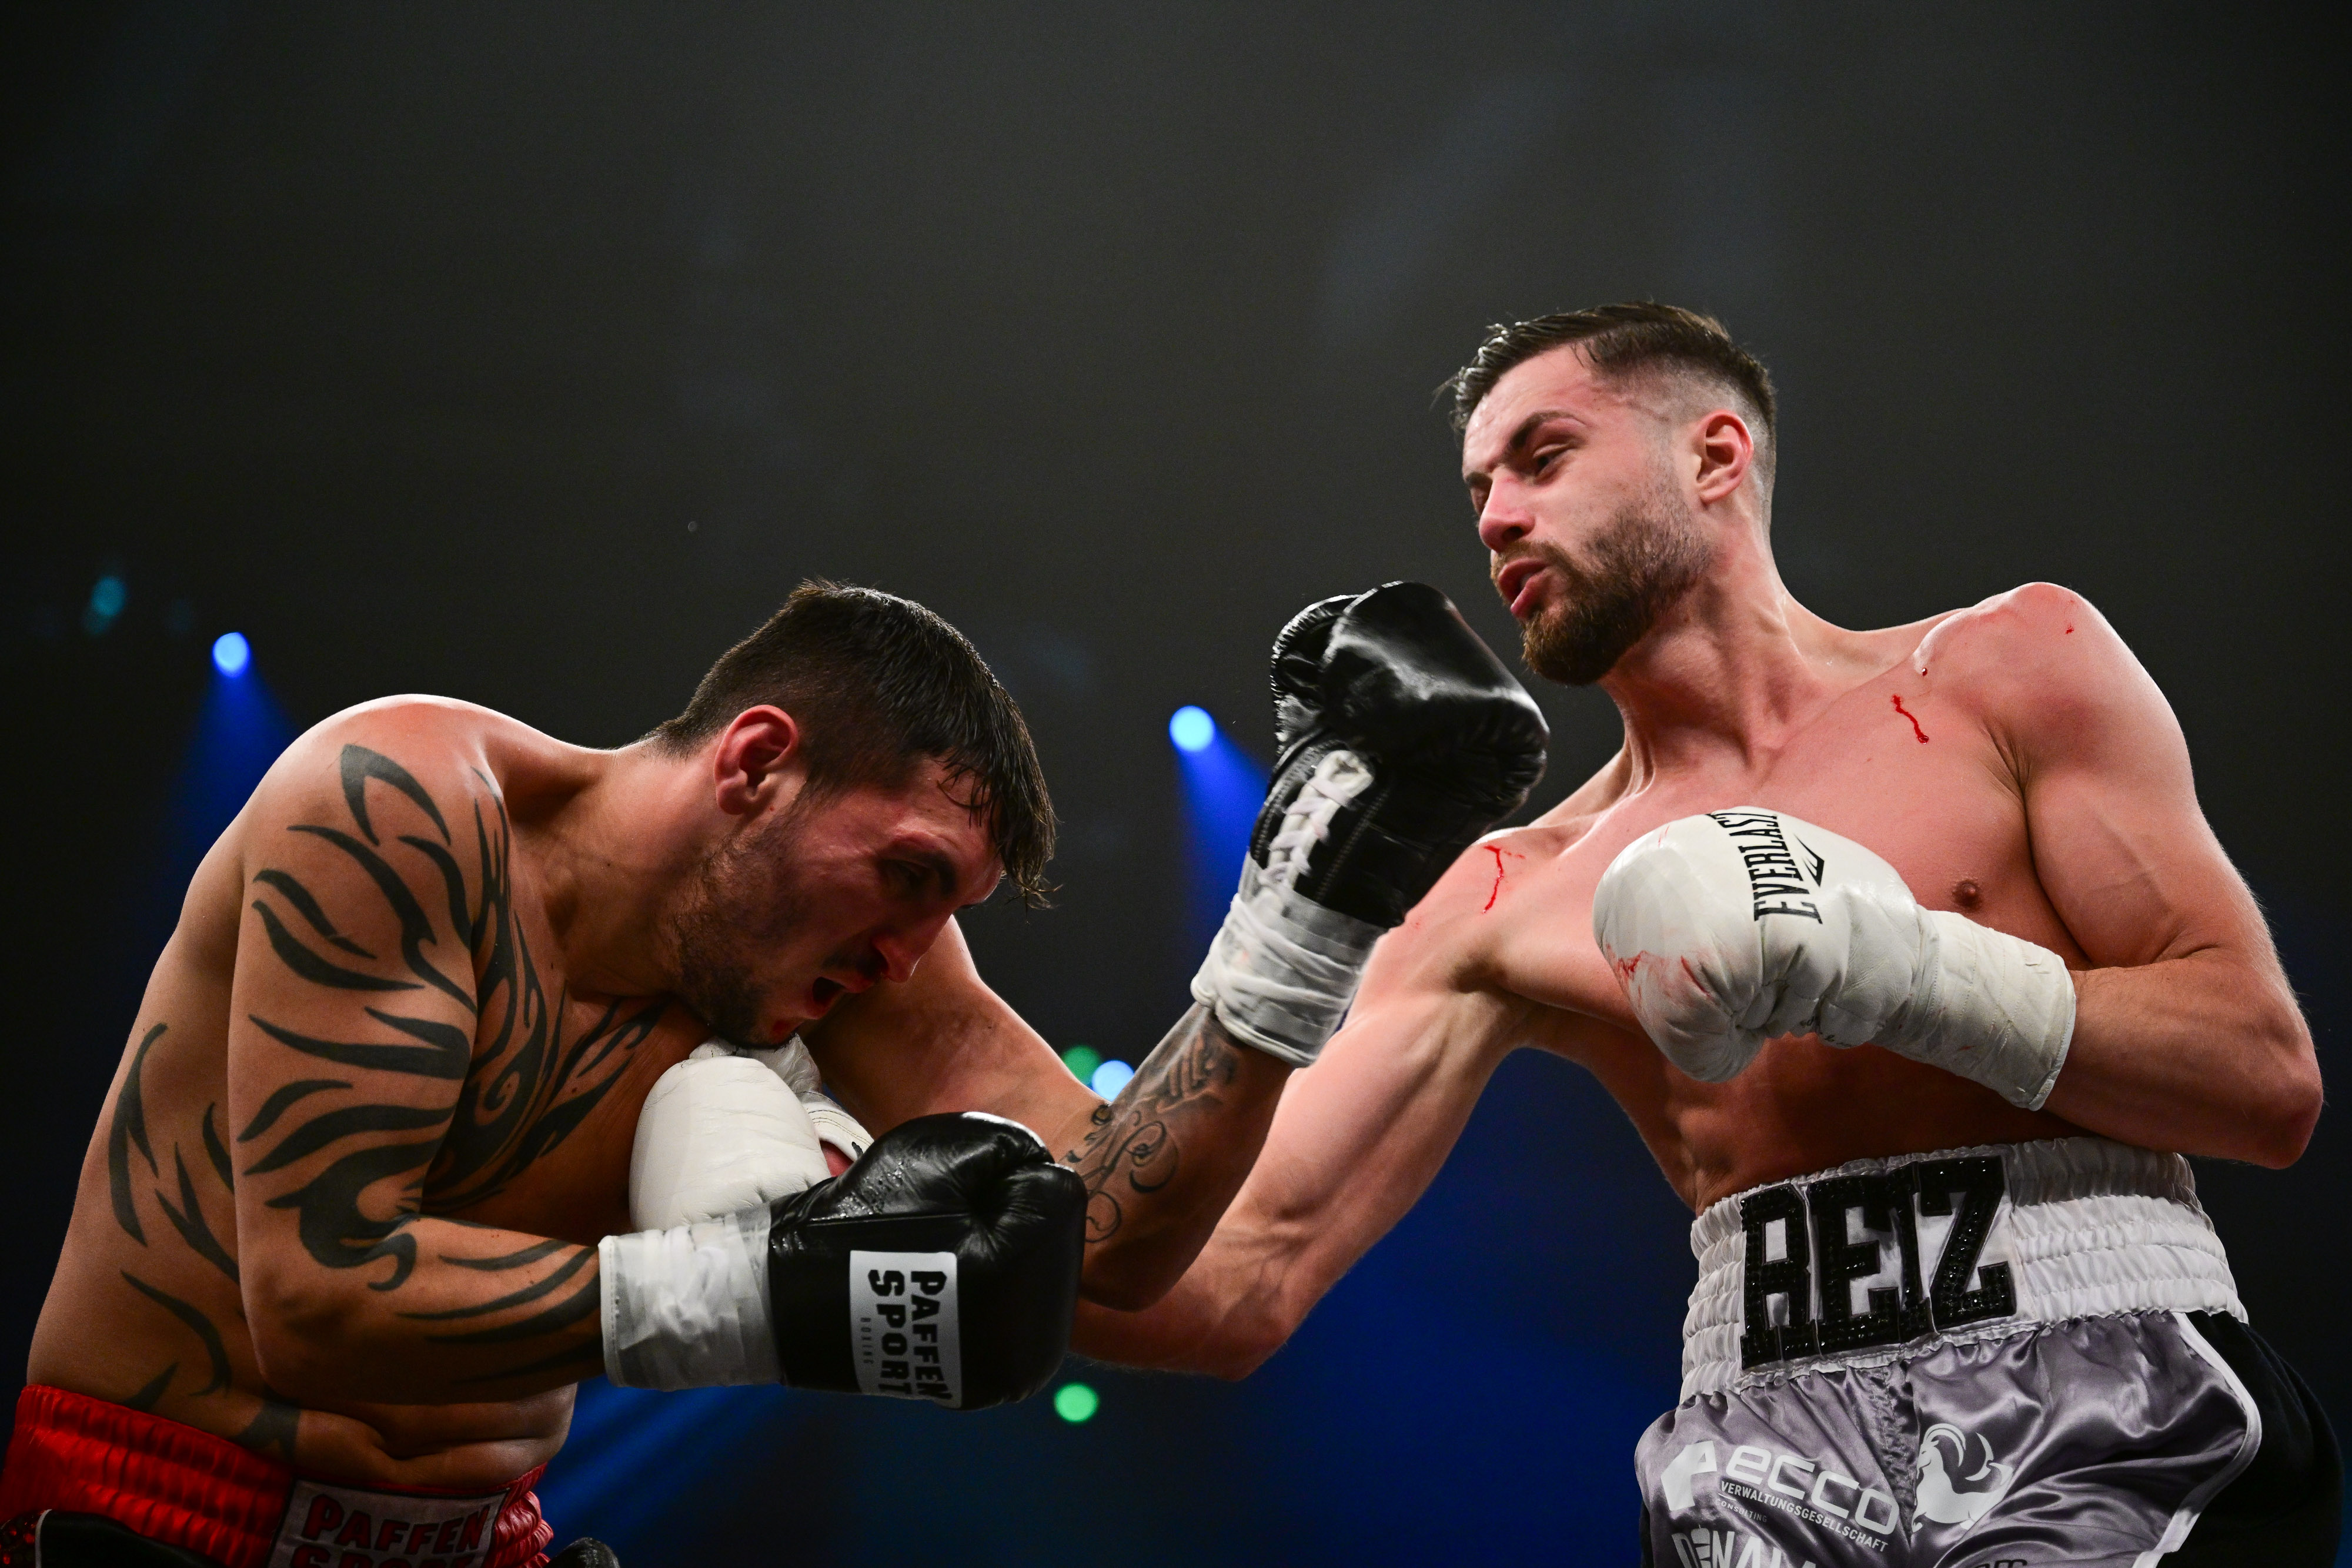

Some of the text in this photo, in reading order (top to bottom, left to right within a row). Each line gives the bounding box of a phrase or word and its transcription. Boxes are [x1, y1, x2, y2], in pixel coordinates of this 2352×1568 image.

[1705, 813, 1823, 925] EVERLAST
[1739, 1155, 2017, 1370] REIZ
[868, 1269, 911, 1395] SPORT
[911, 1271, 953, 1399] PAFFEN
[301, 1494, 491, 1555] PAFFEN
[1715, 1499, 1768, 1523] CONSULTING
[1720, 1480, 1889, 1553] VERWALTUNGSGESELLSCHAFT
